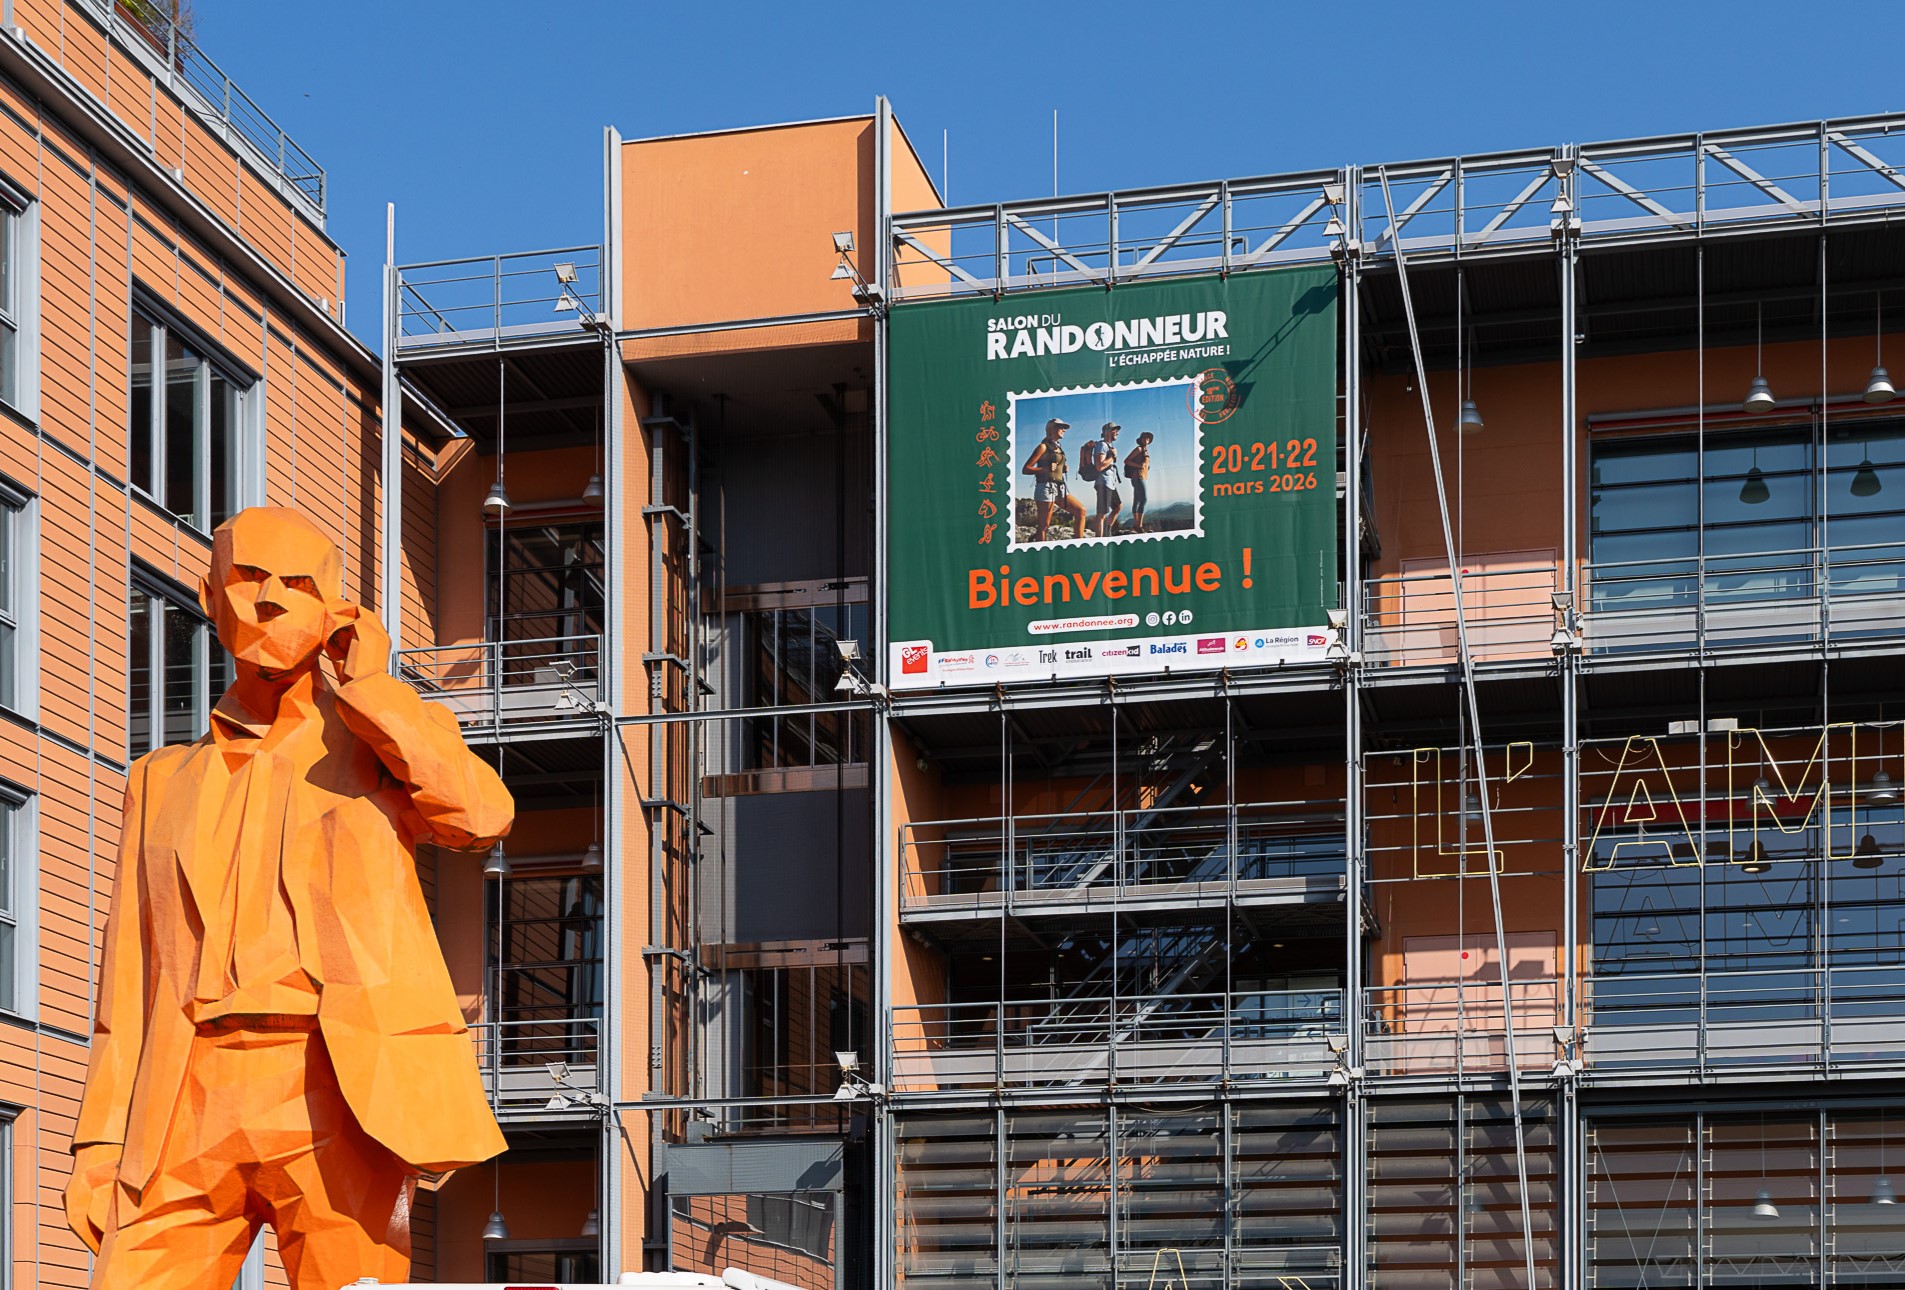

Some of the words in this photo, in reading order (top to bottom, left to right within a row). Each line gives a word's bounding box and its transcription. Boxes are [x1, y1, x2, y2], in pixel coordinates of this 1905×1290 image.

[987, 315, 1038, 332] SALON
[1042, 314, 1061, 326] DU
[987, 311, 1229, 361] RANDONNEUR
[1109, 349, 1177, 368] L'ÉCHAPPÉE
[1179, 346, 1225, 360] NATURE
[1213, 480, 1264, 497] mars
[1269, 472, 1317, 493] 2026
[968, 562, 1222, 609] Bienvenue
[1242, 547, 1254, 589] !
[1033, 617, 1134, 631] www.randonnee.org
[1275, 636, 1299, 645] Région
[902, 647, 918, 659] GL
[906, 646, 928, 665] events
[1038, 649, 1058, 664] Trek
[1065, 647, 1093, 659] trail
[1150, 643, 1187, 655] Balades
